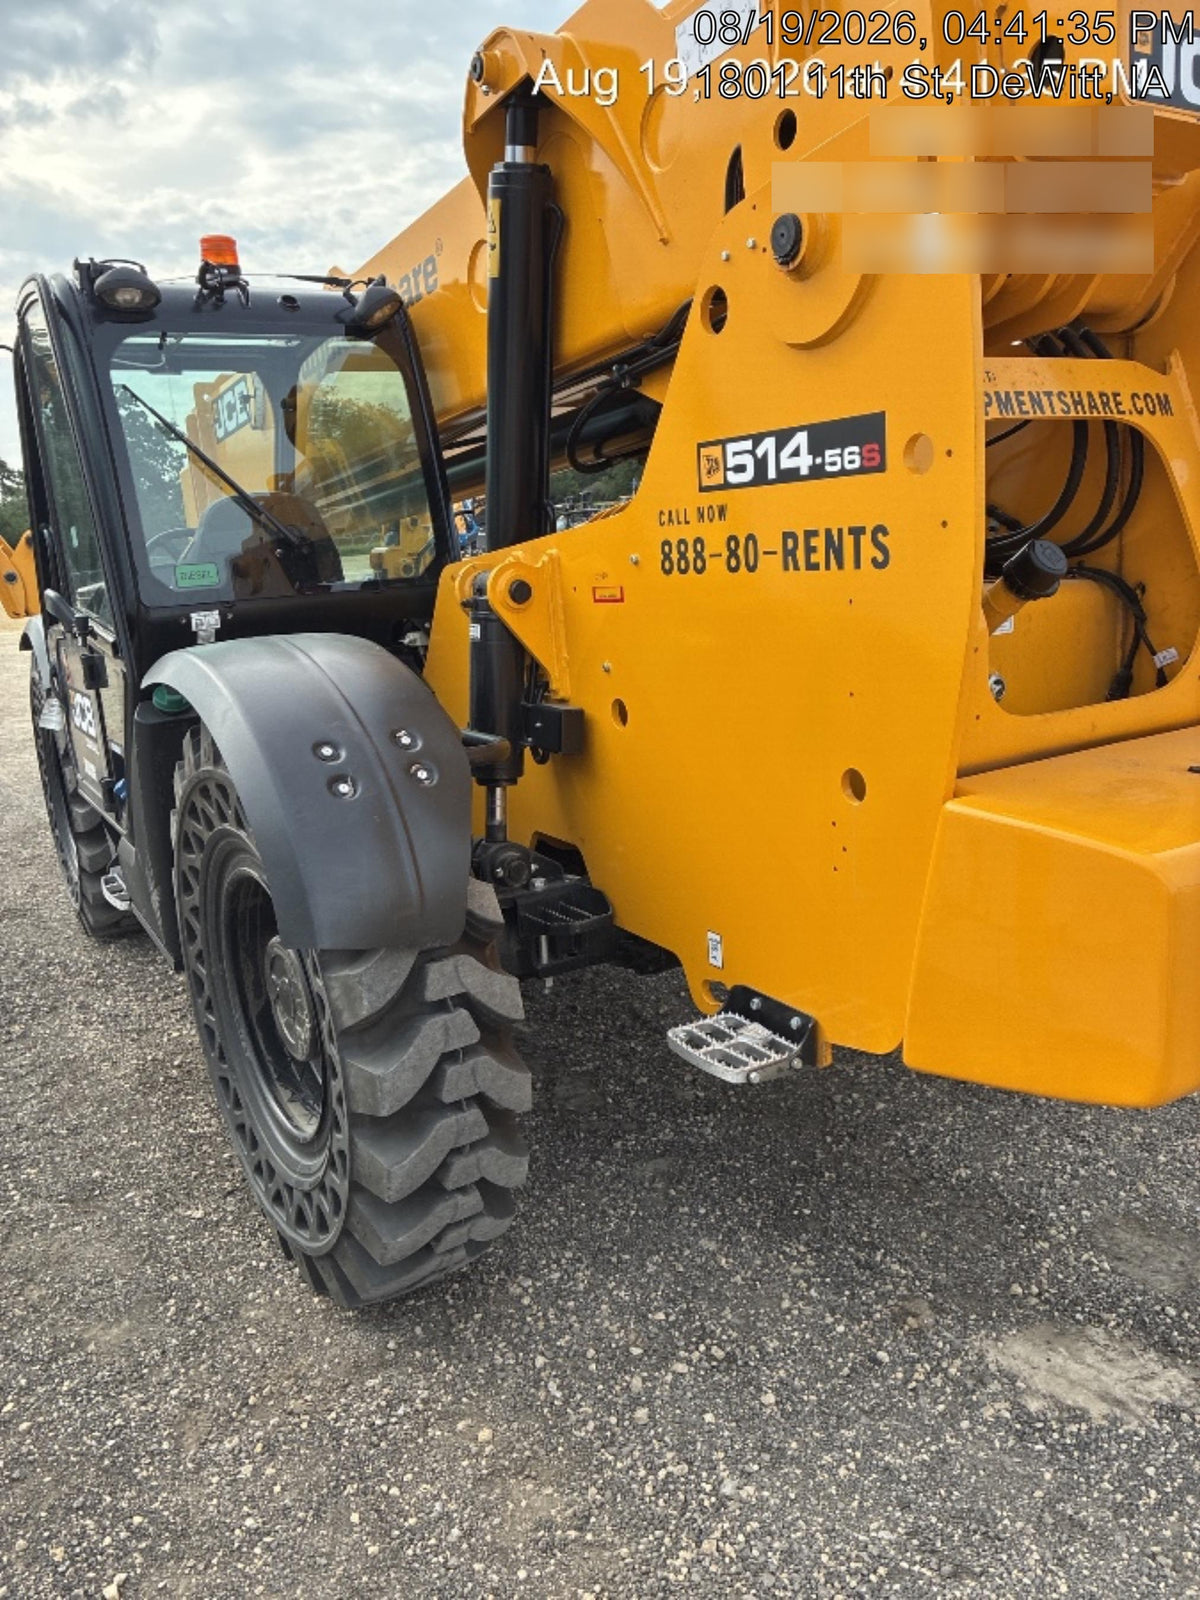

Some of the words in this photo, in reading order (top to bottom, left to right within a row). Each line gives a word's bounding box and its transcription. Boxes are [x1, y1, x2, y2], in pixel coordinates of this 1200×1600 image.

[391, 254, 438, 309] are
[659, 508, 690, 526] CALL
[697, 503, 728, 523] NOW
[661, 523, 890, 575] 888-80-RENTS
